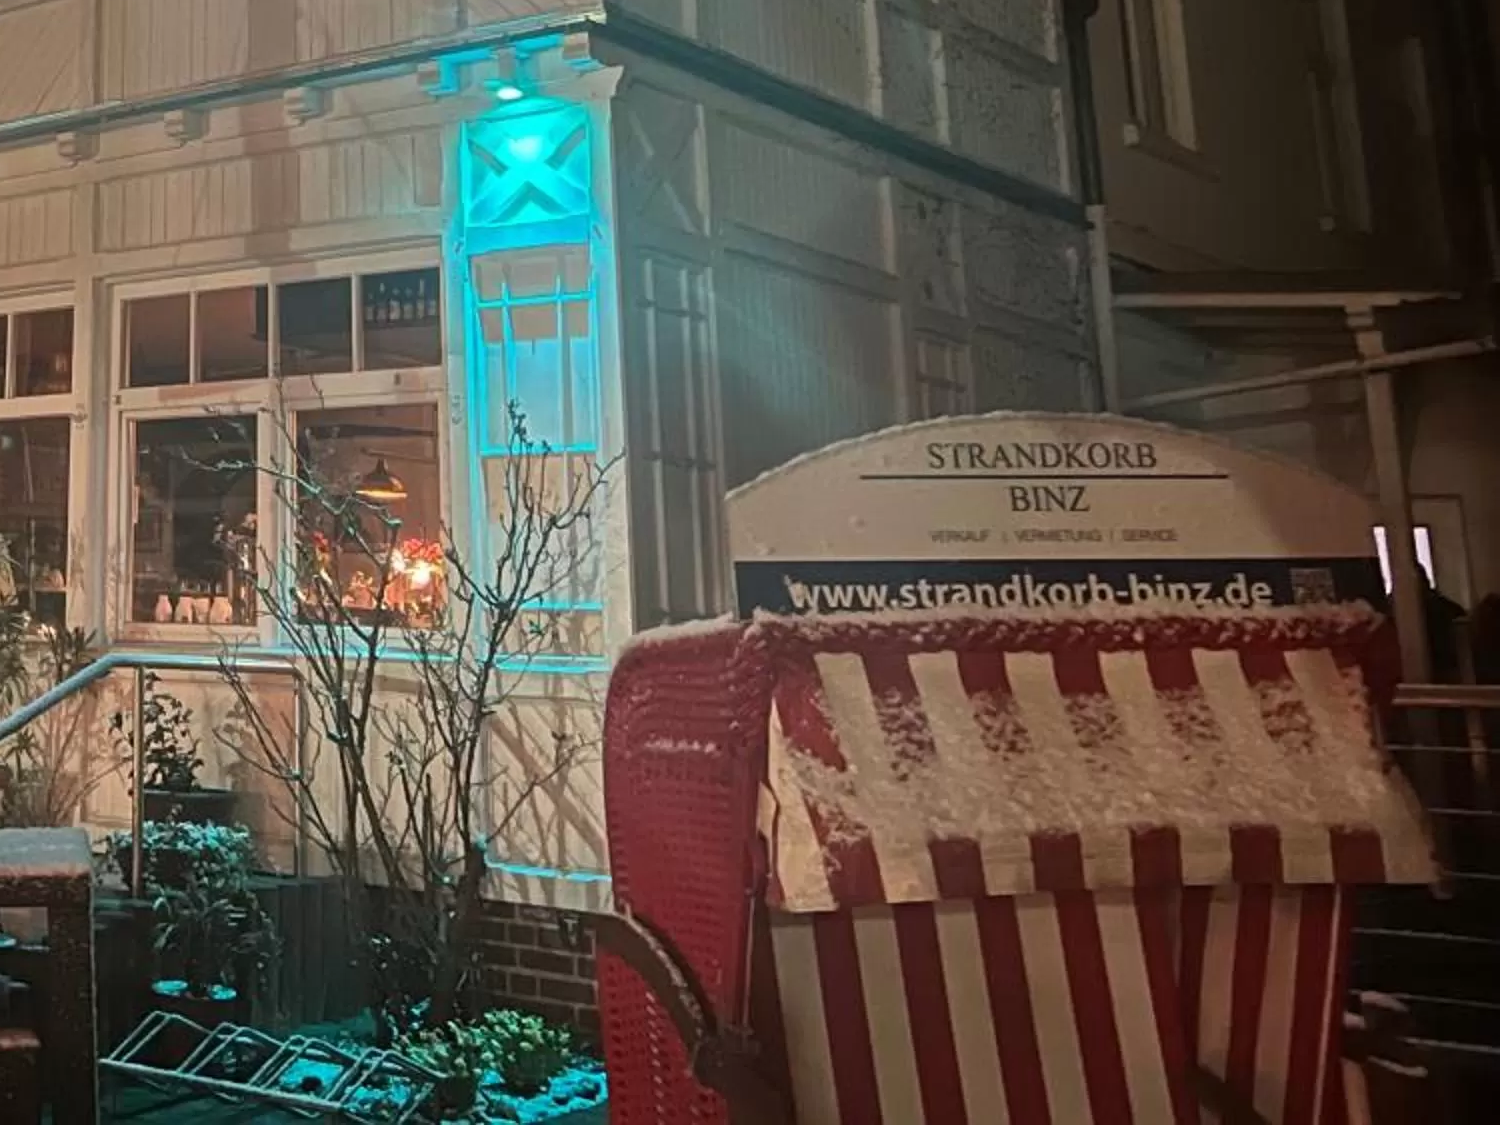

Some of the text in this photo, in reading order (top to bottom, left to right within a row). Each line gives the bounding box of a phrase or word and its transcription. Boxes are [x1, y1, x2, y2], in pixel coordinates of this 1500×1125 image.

[927, 442, 1158, 470] STRANDKORB
[1009, 485, 1091, 512] BINZ
[788, 572, 1273, 609] www.strandkorb-binz.de
